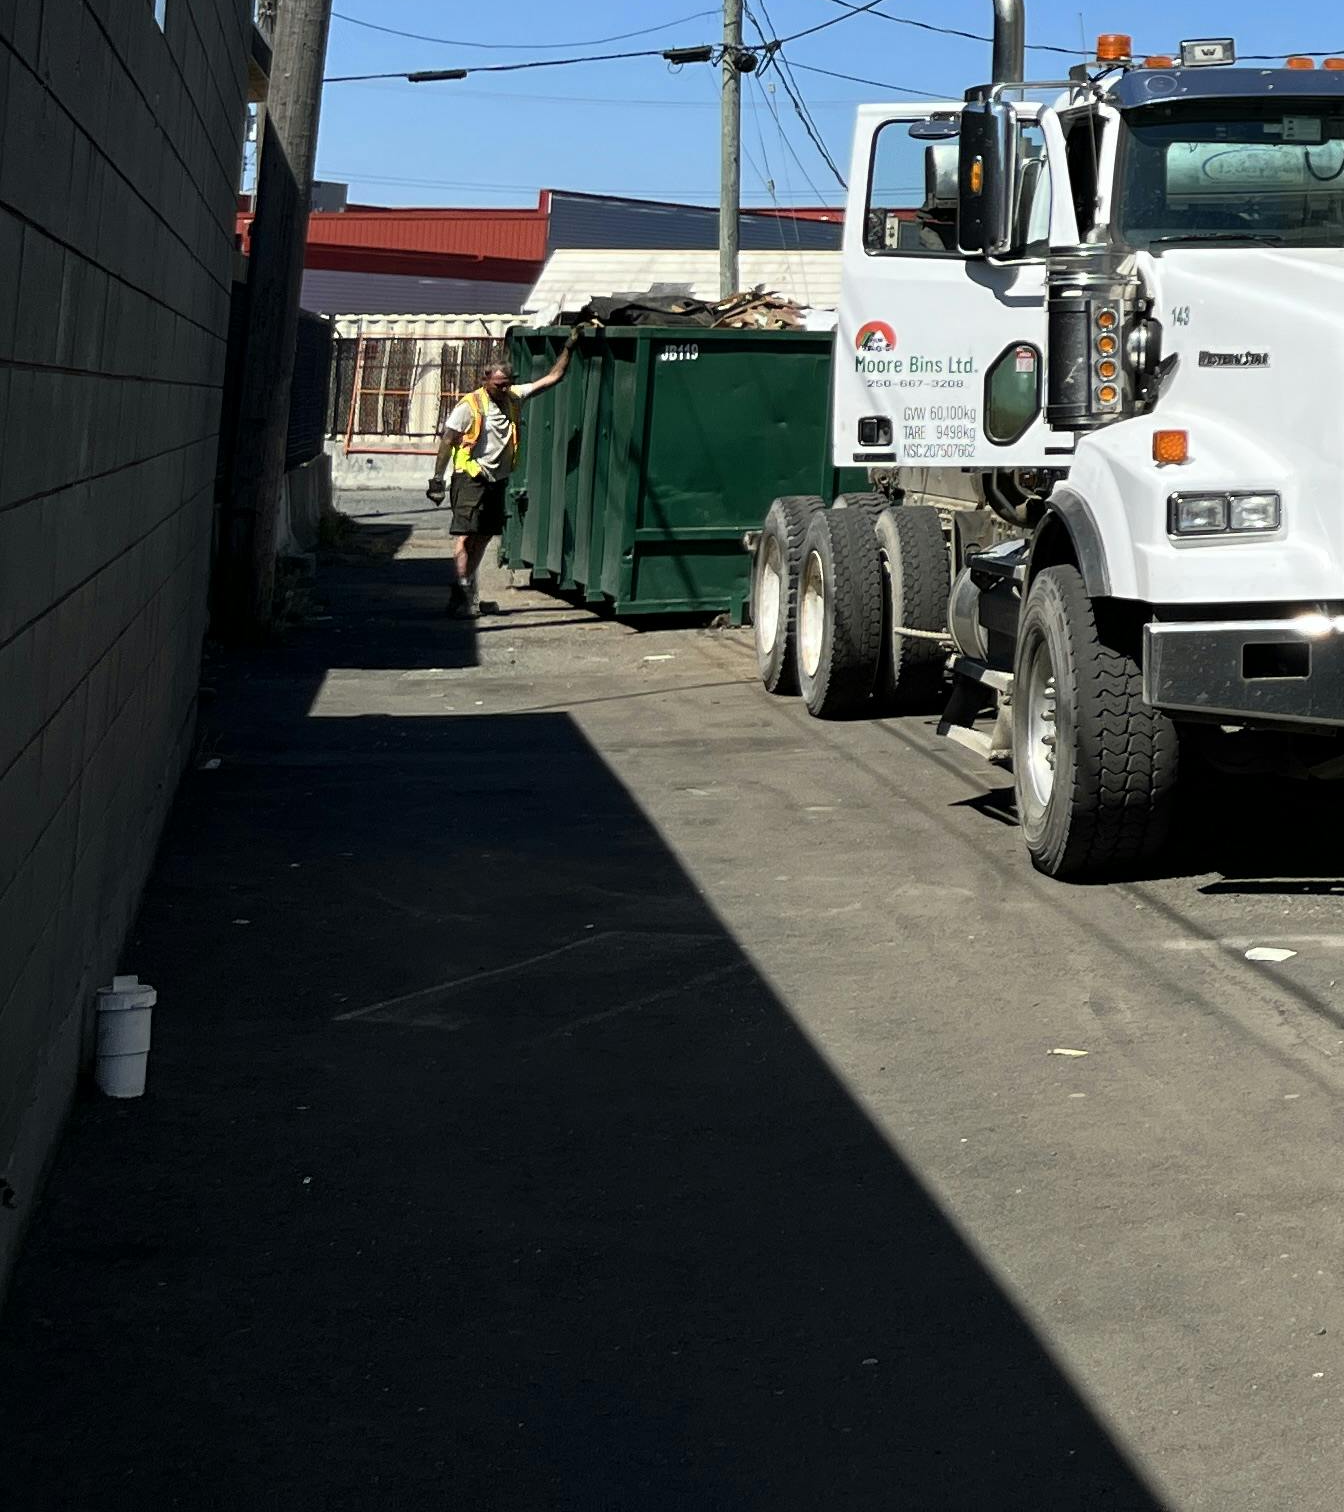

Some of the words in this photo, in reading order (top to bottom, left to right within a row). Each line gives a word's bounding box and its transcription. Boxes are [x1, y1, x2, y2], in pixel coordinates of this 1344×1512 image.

[855, 356, 903, 373] Moore
[909, 356, 943, 373] Bins
[948, 356, 978, 374] Ltd.
[903, 407, 926, 421] GVW
[903, 425, 926, 439] TARE
